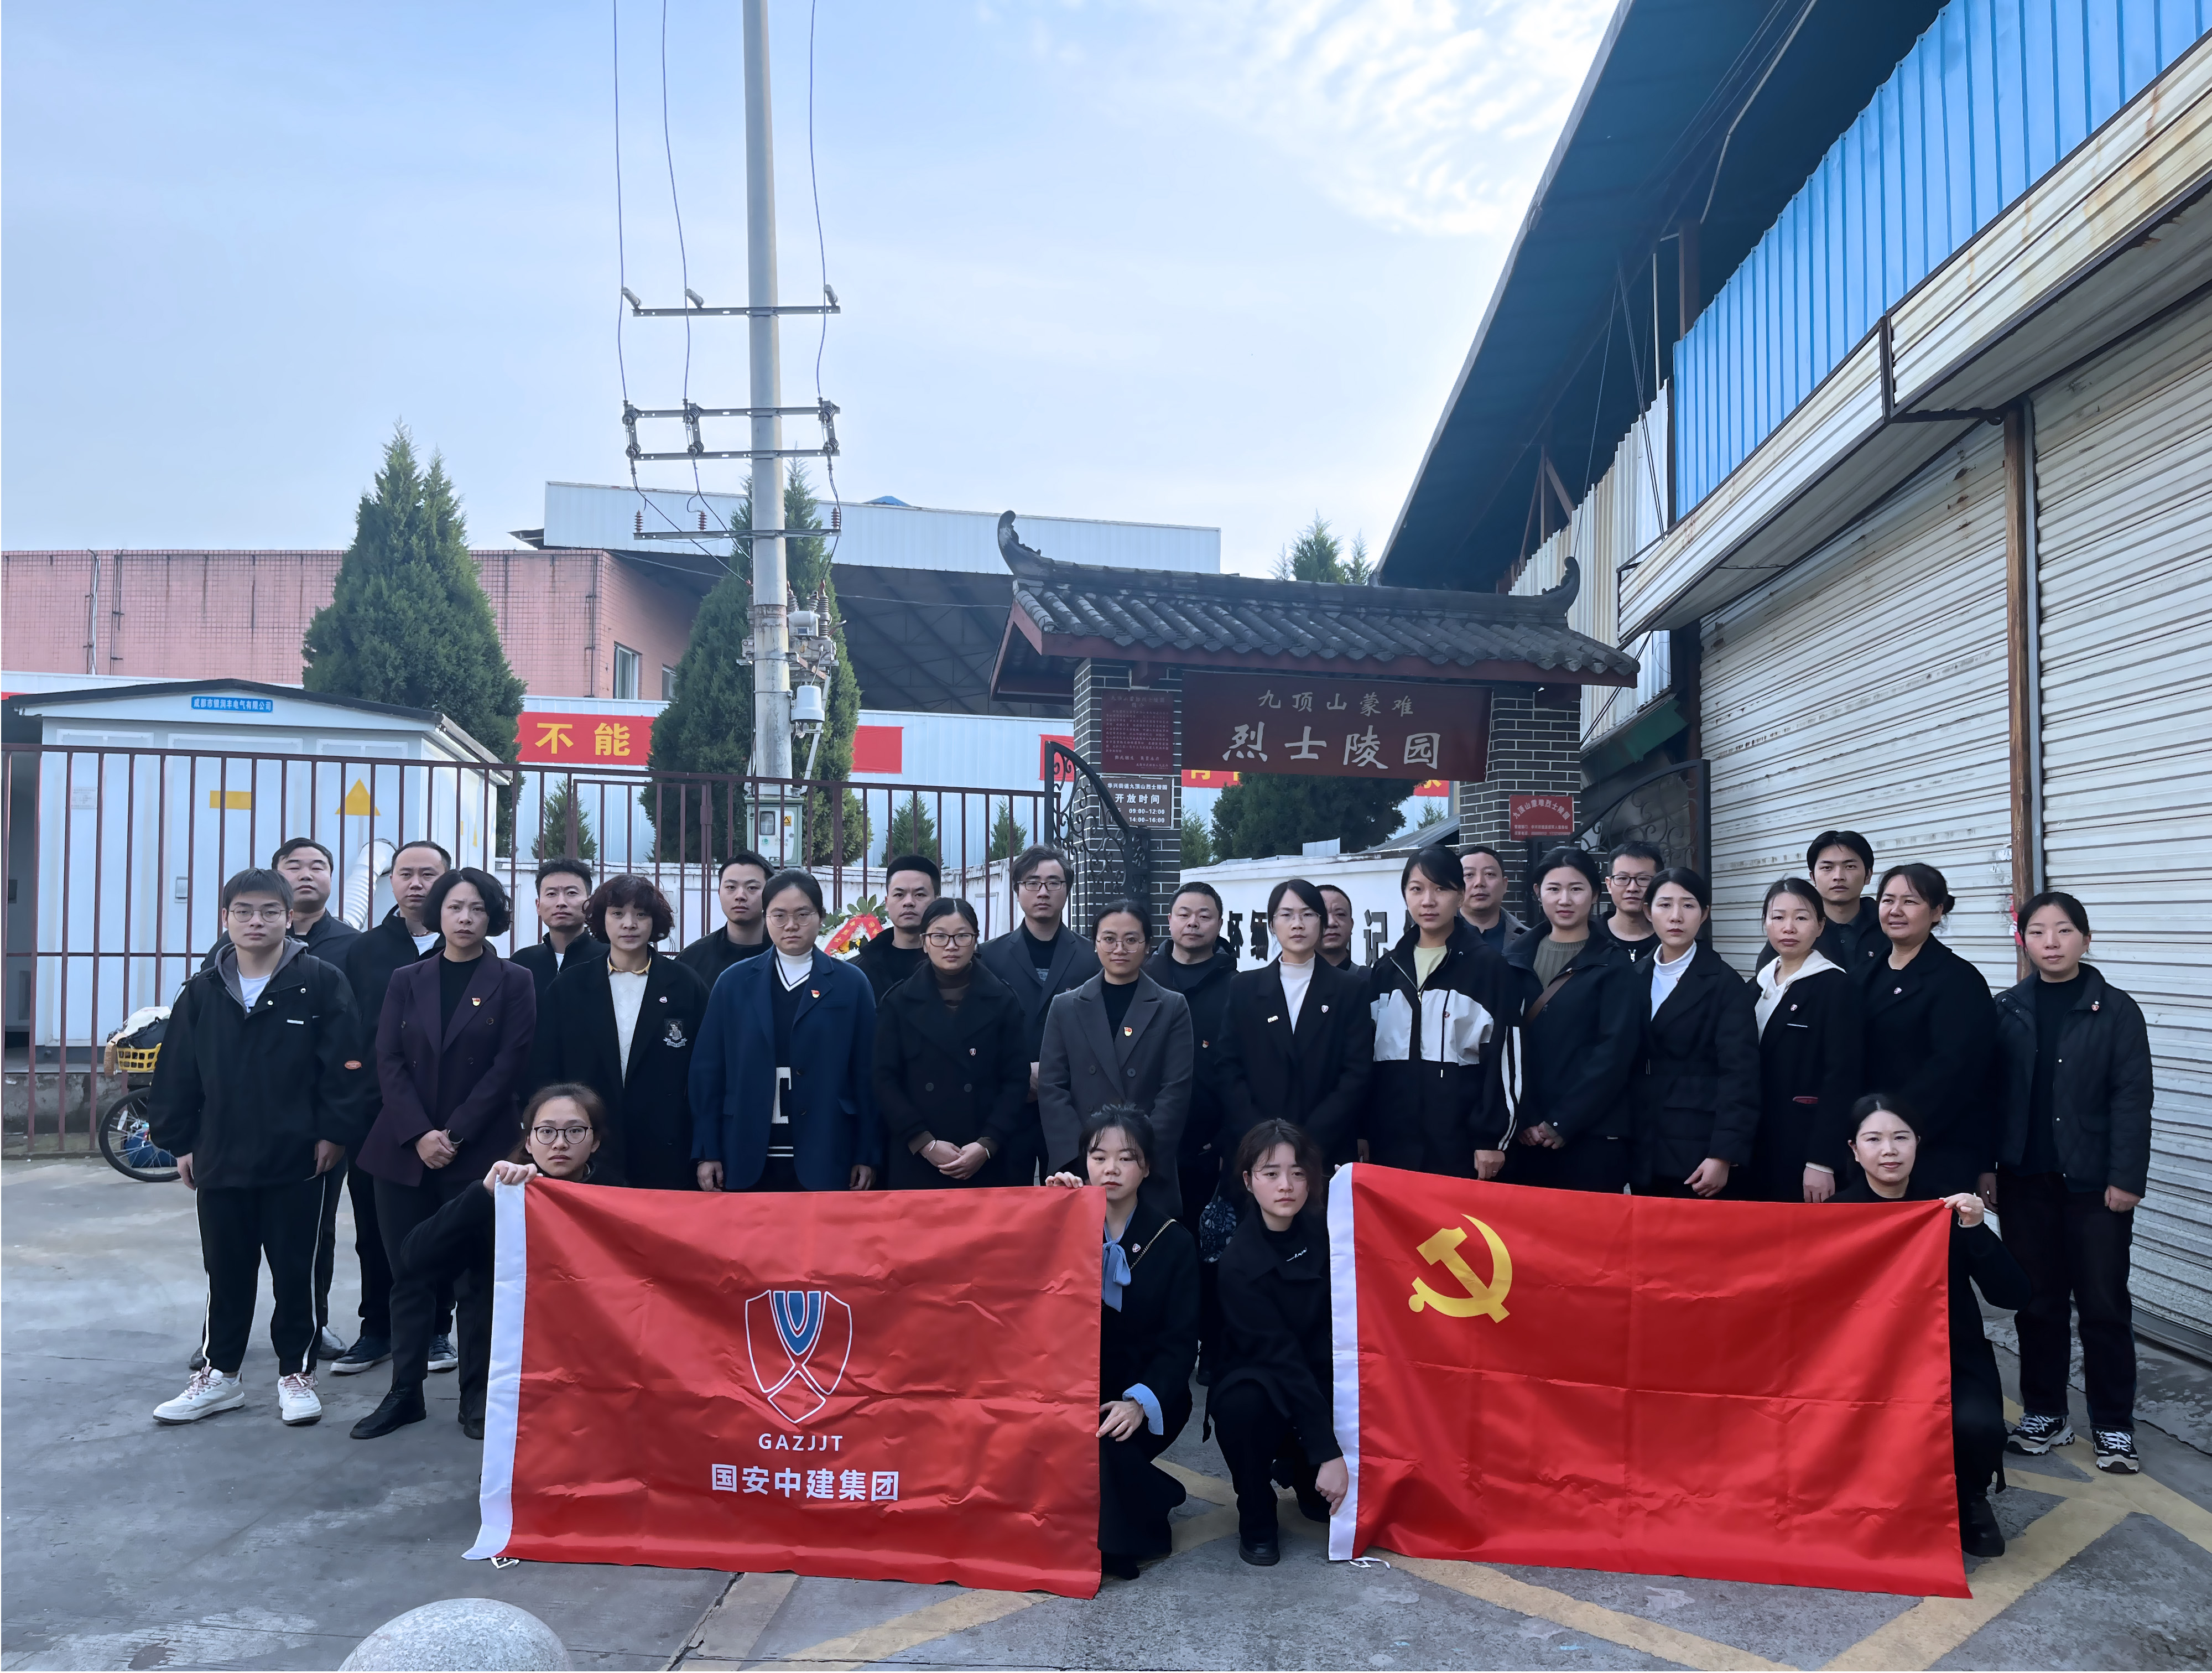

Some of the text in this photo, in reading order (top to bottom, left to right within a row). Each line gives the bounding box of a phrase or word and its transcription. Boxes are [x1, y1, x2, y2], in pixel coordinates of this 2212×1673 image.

[1258, 689, 1414, 718] 九顶山蒙难
[535, 722, 631, 756] 不能
[1222, 721, 1440, 769] 烈士陵园
[1115, 793, 1160, 804] 开放时间
[758, 1433, 843, 1452] GAZJJT
[711, 1463, 899, 1501] 国安中建集团
